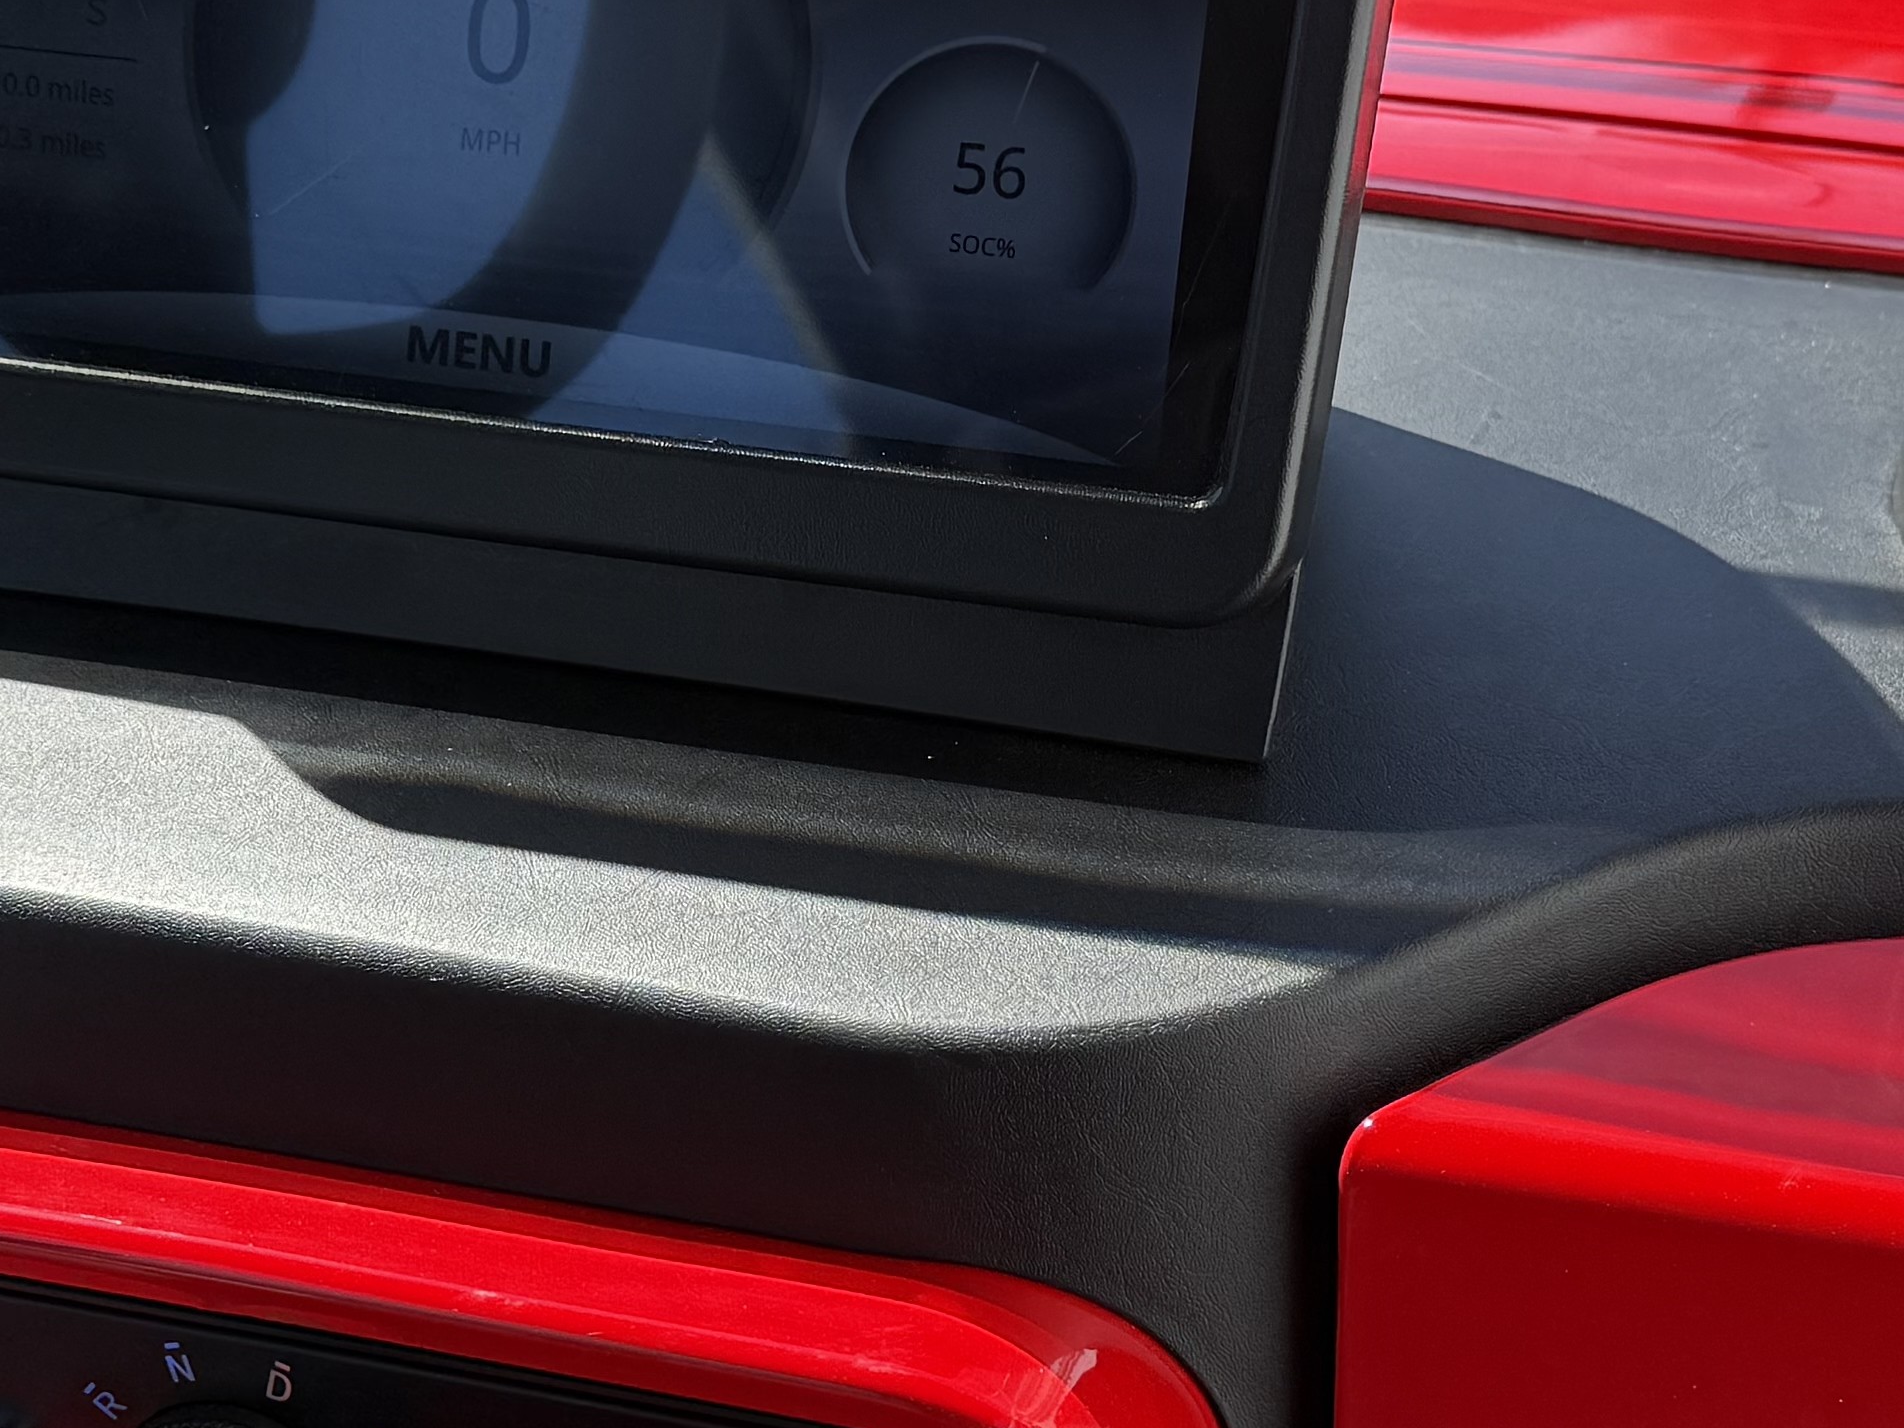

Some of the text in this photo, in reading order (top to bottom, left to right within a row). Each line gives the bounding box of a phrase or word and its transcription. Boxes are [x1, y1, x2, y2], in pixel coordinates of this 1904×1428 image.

[1, 71, 40, 99] 0.0
[47, 79, 115, 108] miles
[41, 130, 107, 160] miles
[460, 127, 522, 157] MPH
[953, 141, 1026, 200] 56
[949, 233, 1016, 259] SOC%
[406, 324, 552, 378] MENU
[92, 1390, 128, 1420] R
[164, 1354, 196, 1383] N
[265, 1368, 293, 1403] D
